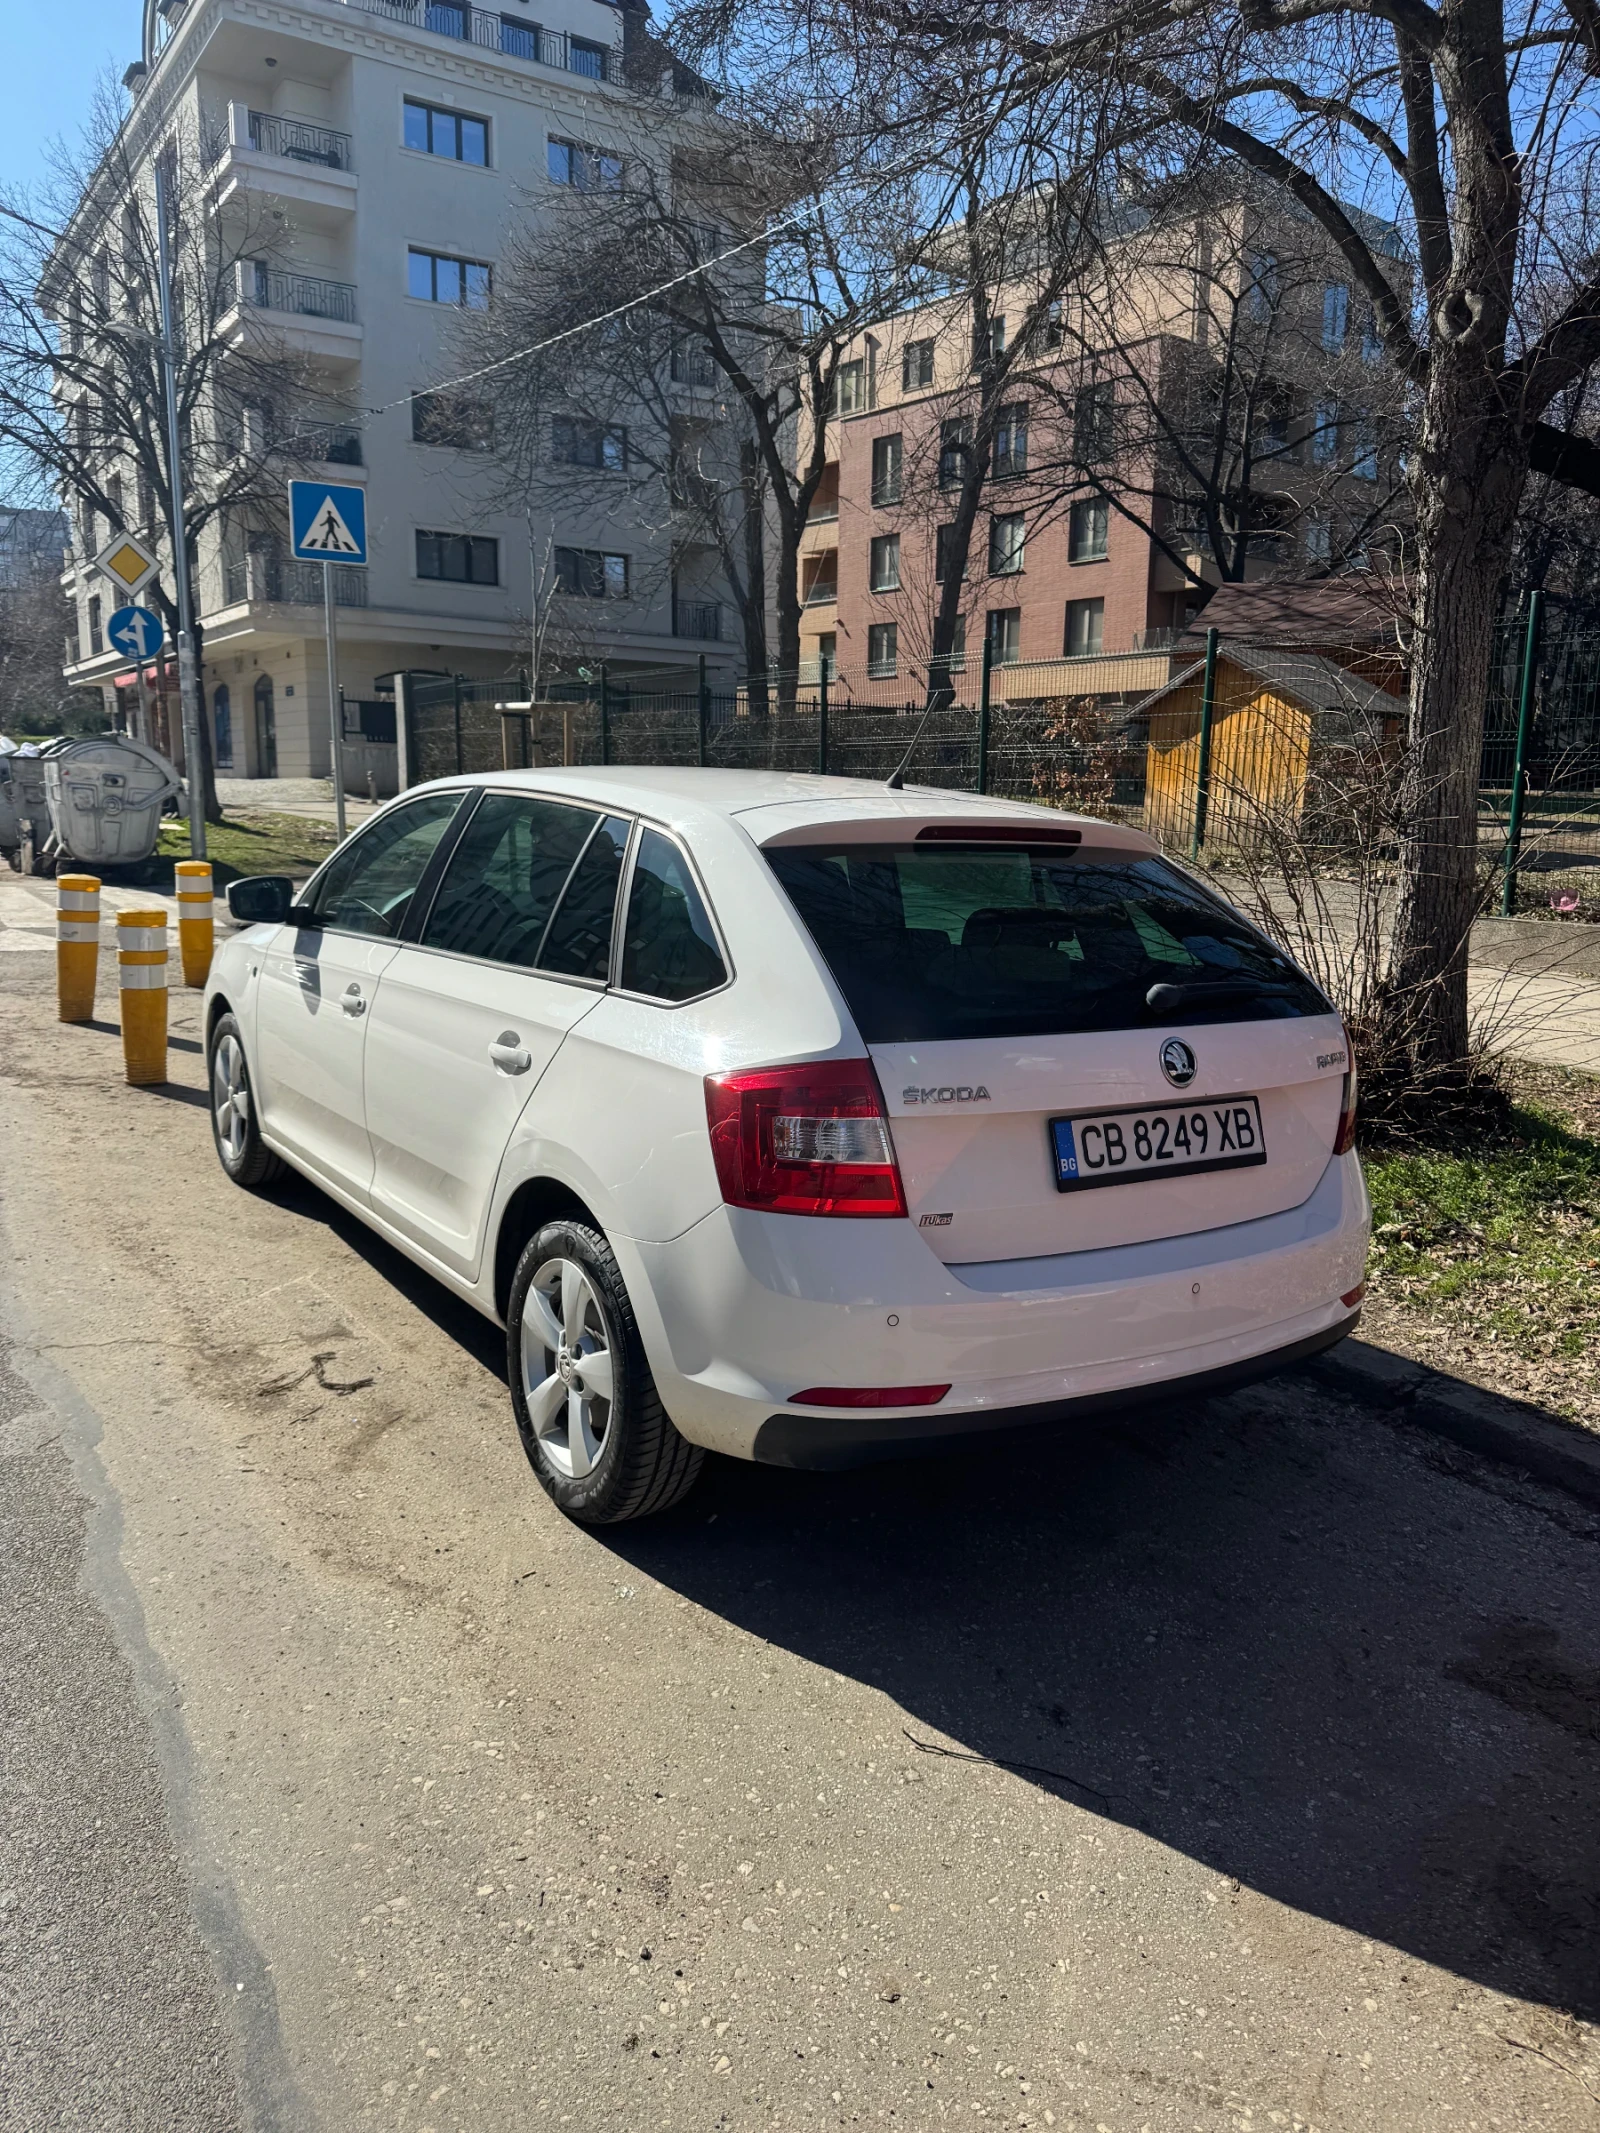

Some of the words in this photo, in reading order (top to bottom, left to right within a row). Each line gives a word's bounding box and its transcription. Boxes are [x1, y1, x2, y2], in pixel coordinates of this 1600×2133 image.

[902, 1085, 992, 1105] ŠKODA
[1080, 1122, 1128, 1169] CB
[1133, 1112, 1209, 1162] 8249
[1213, 1107, 1255, 1152] XB
[1060, 1157, 1077, 1172] BG
